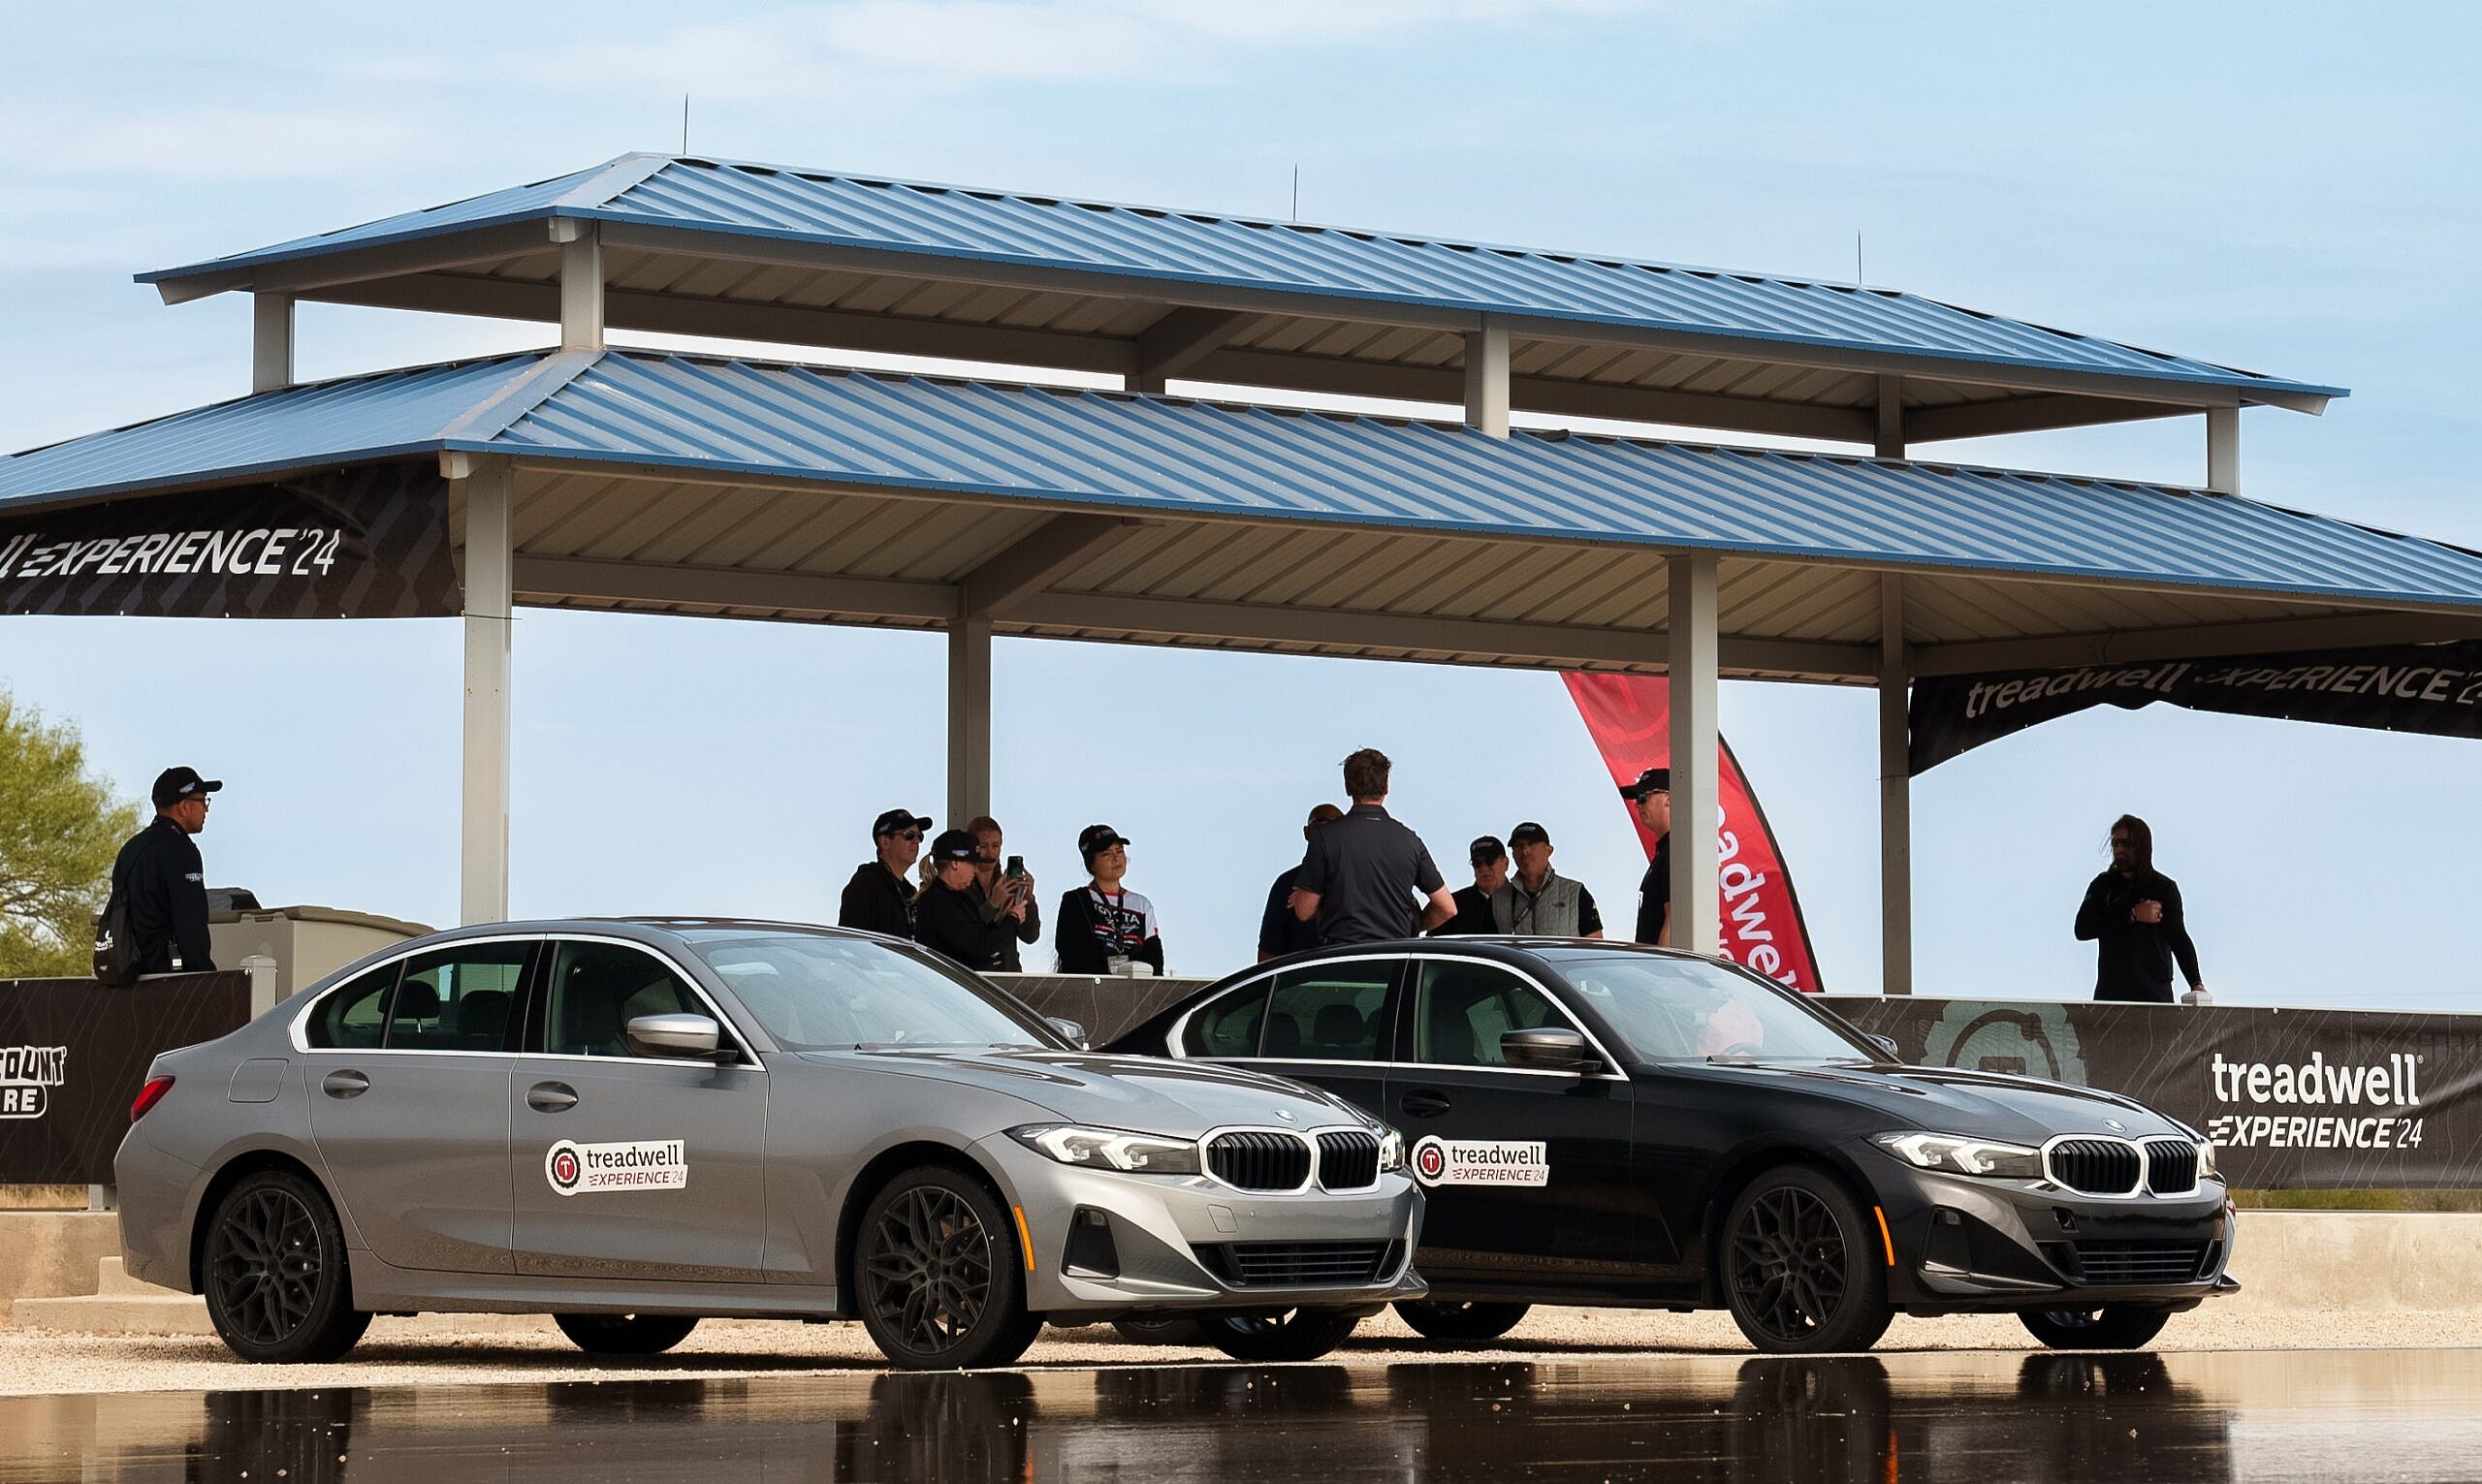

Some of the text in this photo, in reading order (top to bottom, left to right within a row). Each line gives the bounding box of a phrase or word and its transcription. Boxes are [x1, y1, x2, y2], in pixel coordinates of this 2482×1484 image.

[16, 528, 299, 578] EXPERIENCE
[292, 527, 340, 576] '24
[1965, 663, 2191, 718] treadwell
[2456, 670, 2482, 705] '2
[2212, 1051, 2420, 1106] treadwell
[2208, 1116, 2423, 1149] EXPERIENCE '24
[587, 1144, 679, 1169] treadwell
[1425, 1153, 1436, 1169] T
[1451, 1145, 1541, 1165] treadwell
[560, 1160, 571, 1176] T
[588, 1171, 671, 1186] EXPERIENCE
[1451, 1168, 1532, 1182] EXPERIENCE
